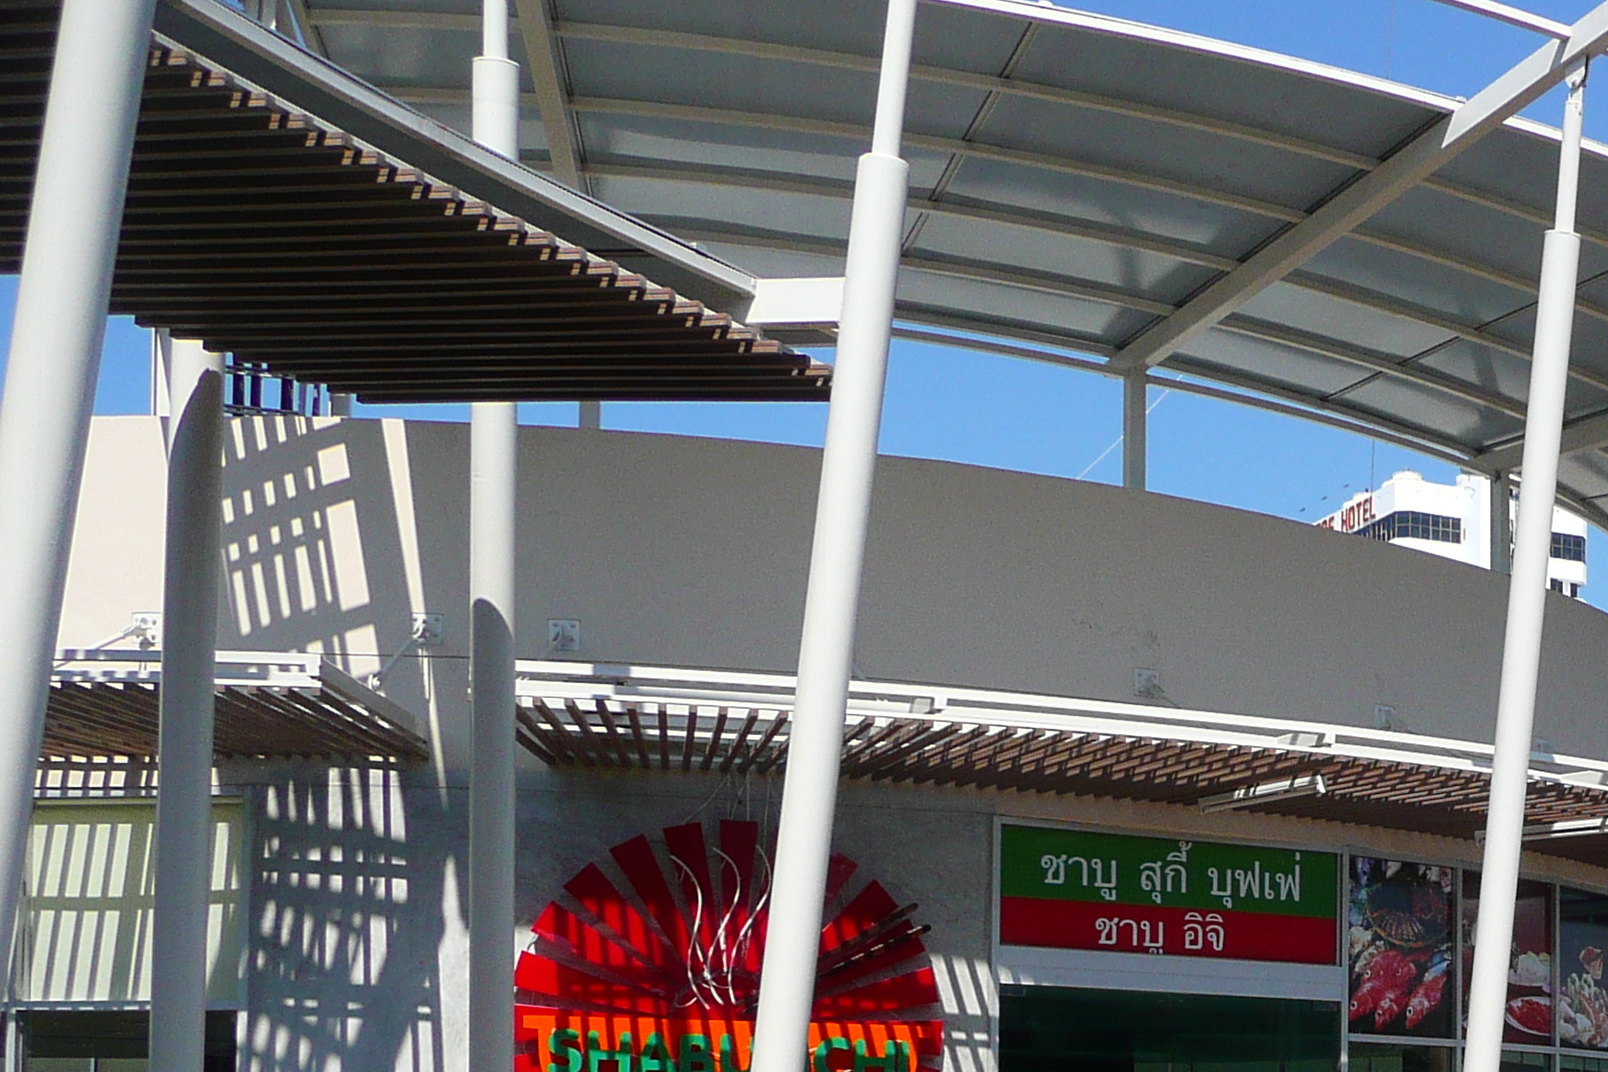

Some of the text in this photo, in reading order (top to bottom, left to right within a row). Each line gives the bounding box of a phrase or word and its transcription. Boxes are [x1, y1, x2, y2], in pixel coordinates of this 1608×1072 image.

[1341, 496, 1376, 532] HOTEL
[1040, 840, 1301, 909] ชาบู สุกี้ บุฟเฟ่
[1183, 911, 1226, 952] อิจิ
